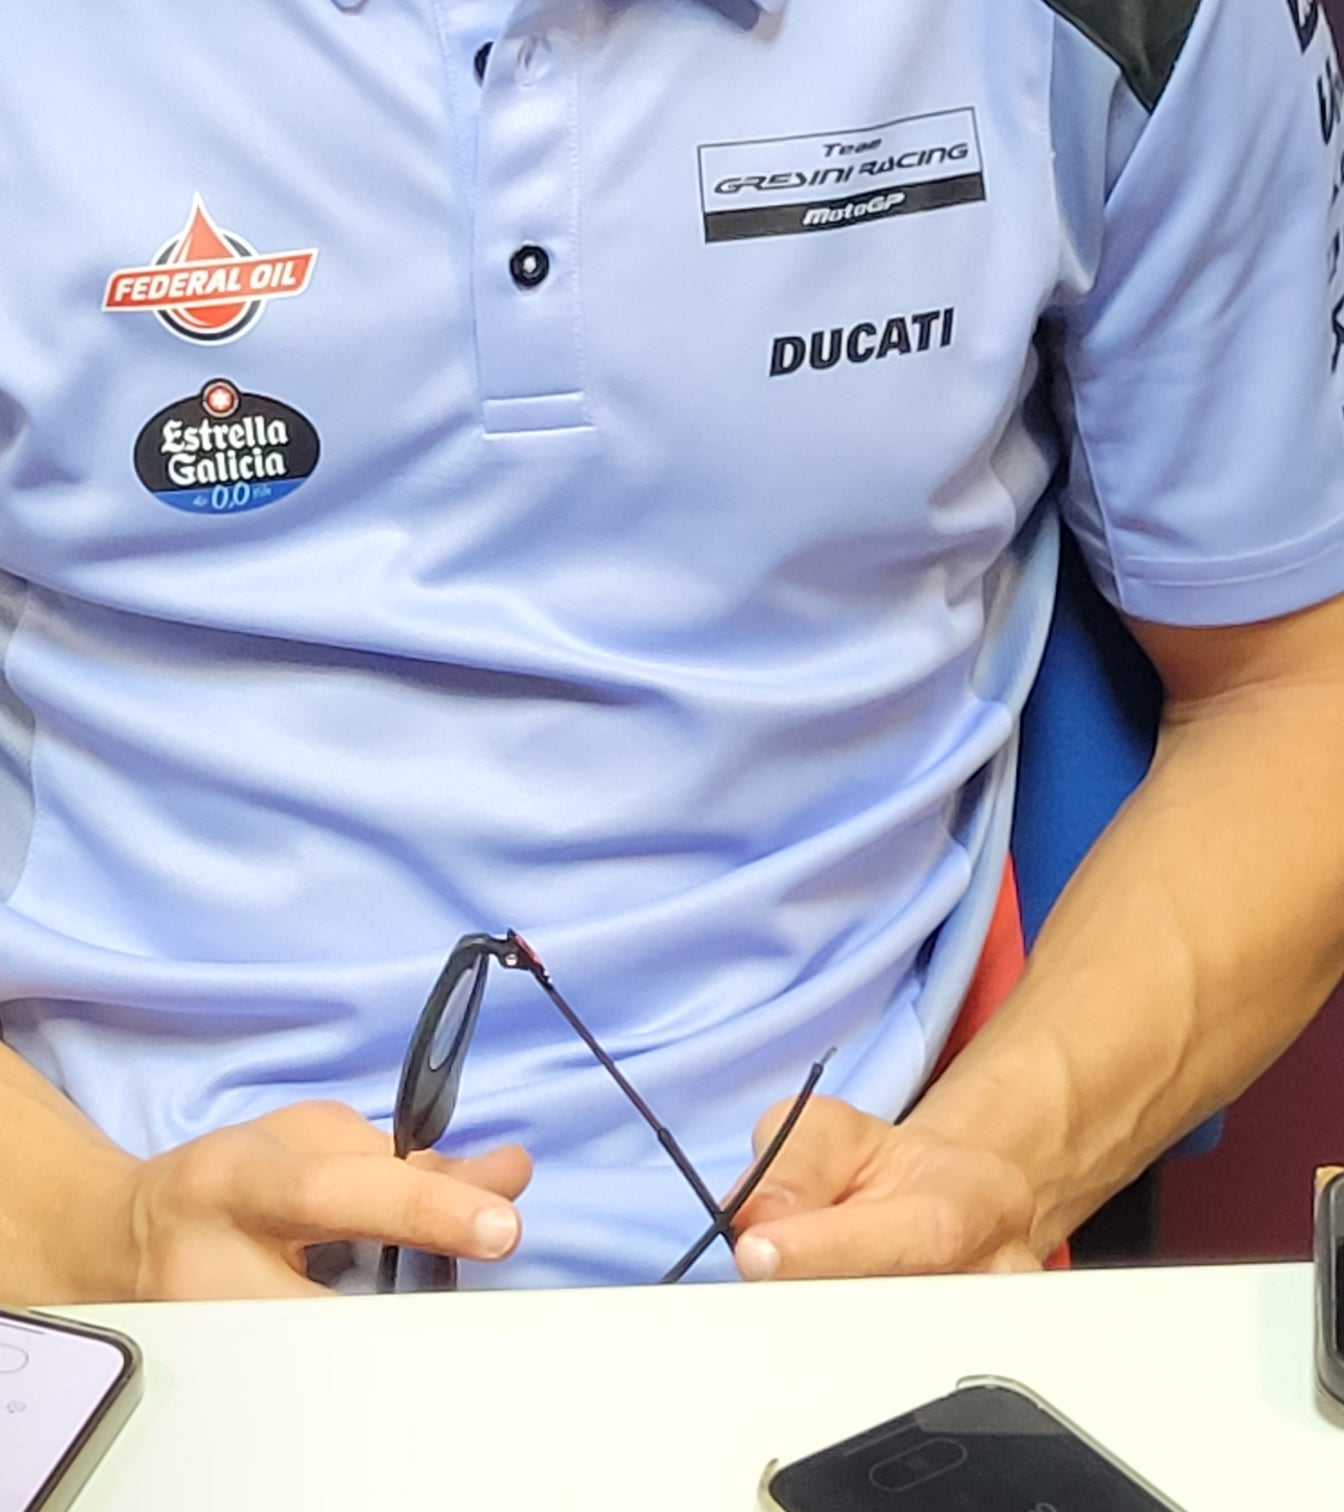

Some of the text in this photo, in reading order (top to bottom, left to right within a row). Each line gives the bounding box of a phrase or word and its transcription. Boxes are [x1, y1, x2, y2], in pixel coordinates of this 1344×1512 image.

[714, 143, 968, 194] GRESINI RACING
[114, 261, 297, 302] FEDERAL OIL
[768, 307, 955, 377] DUCATI
[161, 415, 289, 454] Estrella
[168, 447, 287, 486] Galicia
